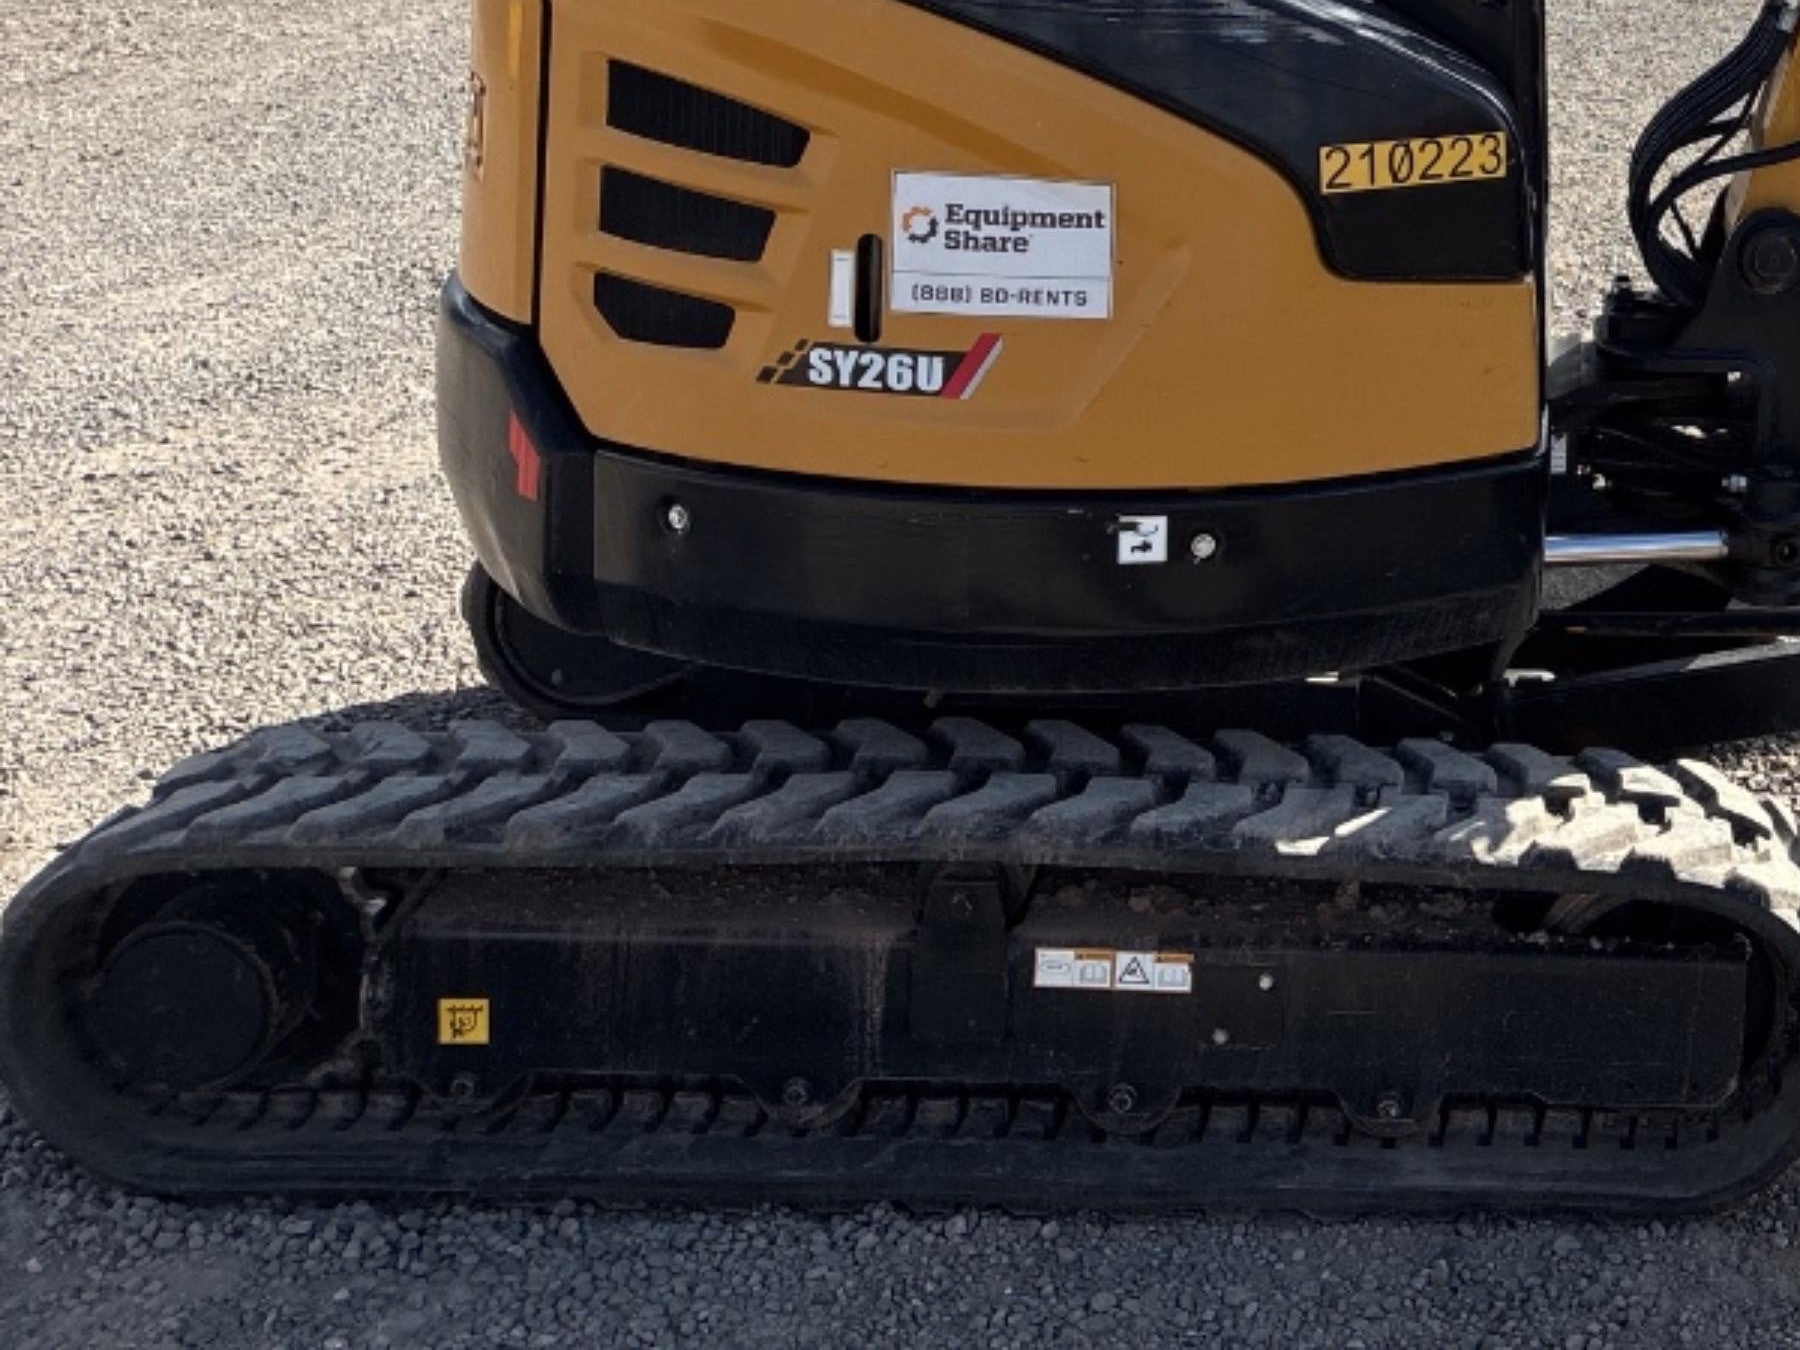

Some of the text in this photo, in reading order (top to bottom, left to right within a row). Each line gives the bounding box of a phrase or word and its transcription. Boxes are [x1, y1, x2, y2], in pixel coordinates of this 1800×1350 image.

[1325, 134, 1501, 189] 210223
[944, 203, 1105, 232] Equipment
[944, 230, 1030, 253] Share
[808, 347, 944, 392] SY26U
